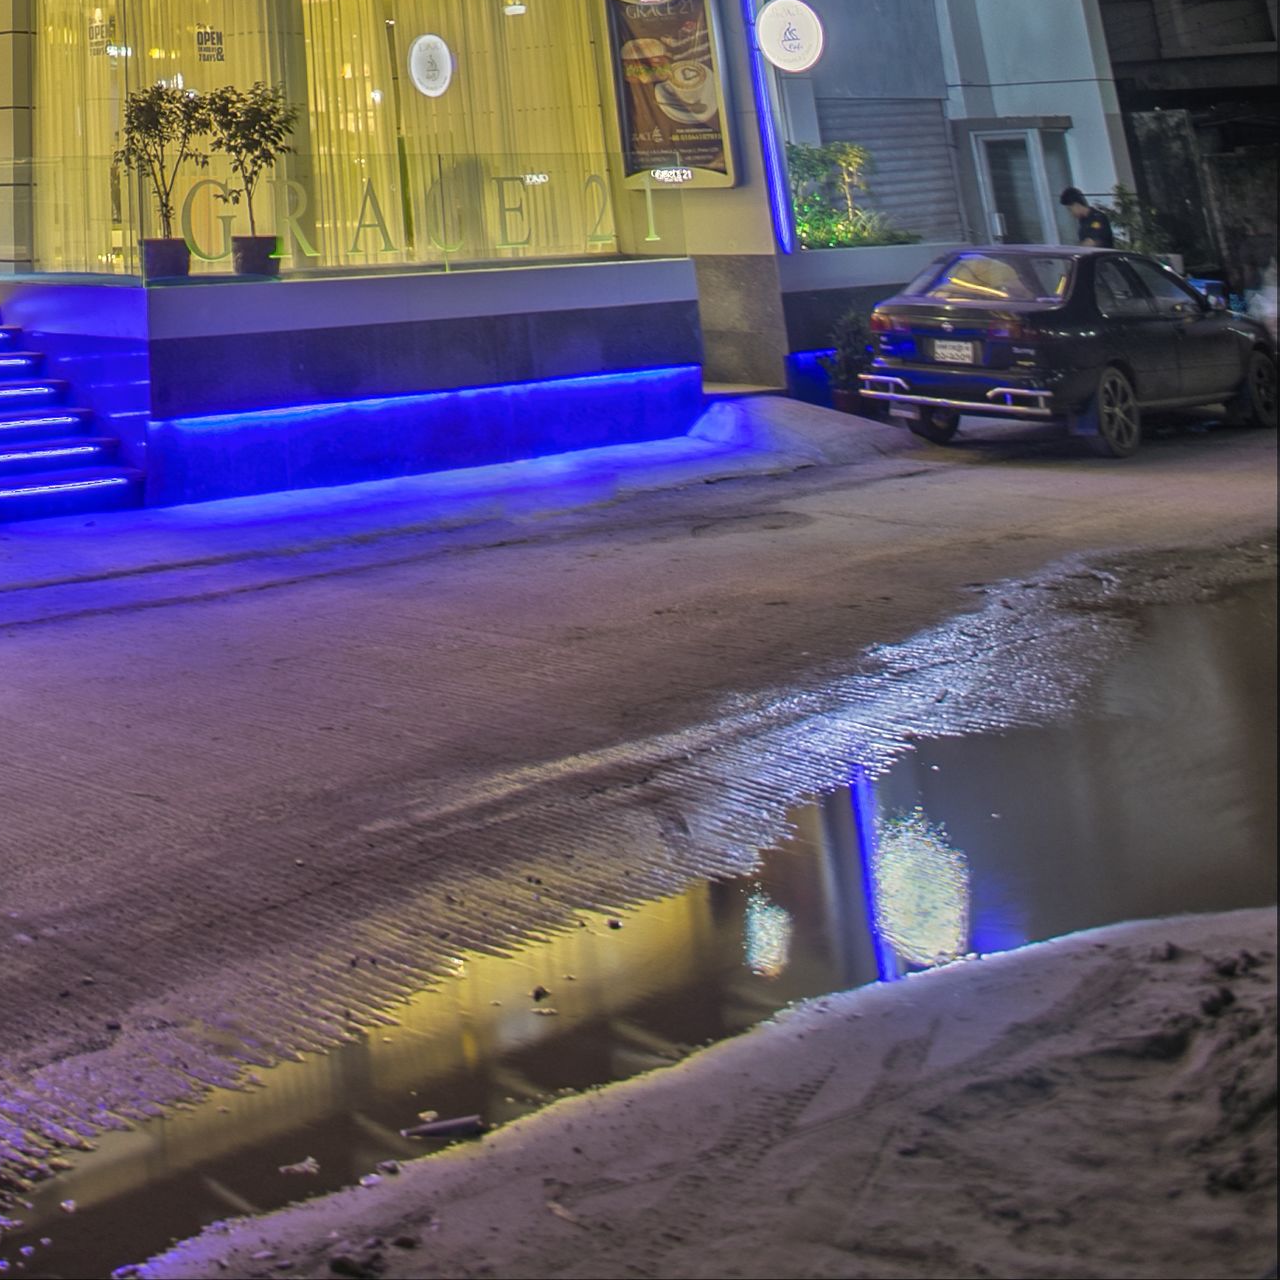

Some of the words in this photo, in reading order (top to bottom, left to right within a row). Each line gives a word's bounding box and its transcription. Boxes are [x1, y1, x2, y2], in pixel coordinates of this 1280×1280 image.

[625, 2, 677, 19] GRACE
[679, 0, 695, 14] 21
[197, 31, 223, 46] OPEN
[181, 175, 533, 262] GRACE
[582, 173, 661, 244] 21
